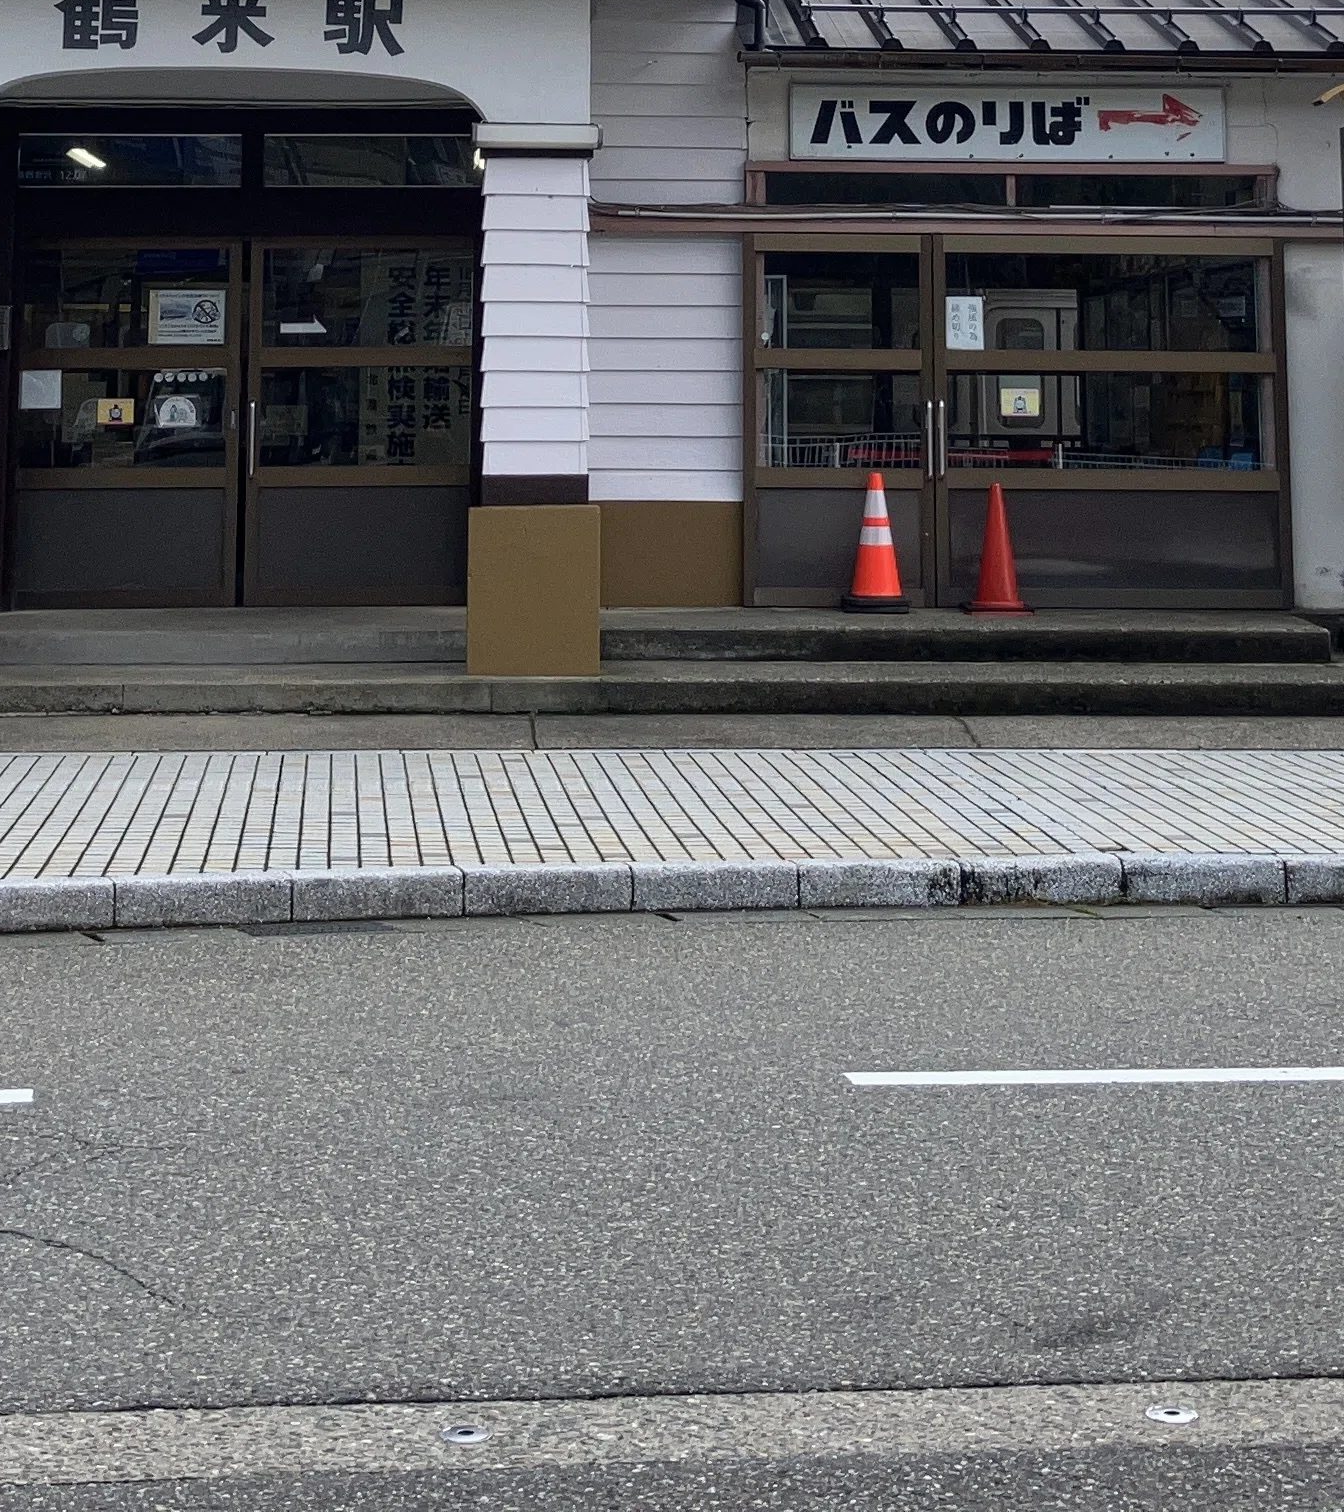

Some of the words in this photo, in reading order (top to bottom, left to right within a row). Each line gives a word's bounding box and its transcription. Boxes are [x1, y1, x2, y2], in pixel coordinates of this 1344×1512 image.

[810, 96, 1090, 145] バスのりば
[387, 266, 416, 465] 安全総検実施
[422, 266, 451, 429] 年末年輸送
